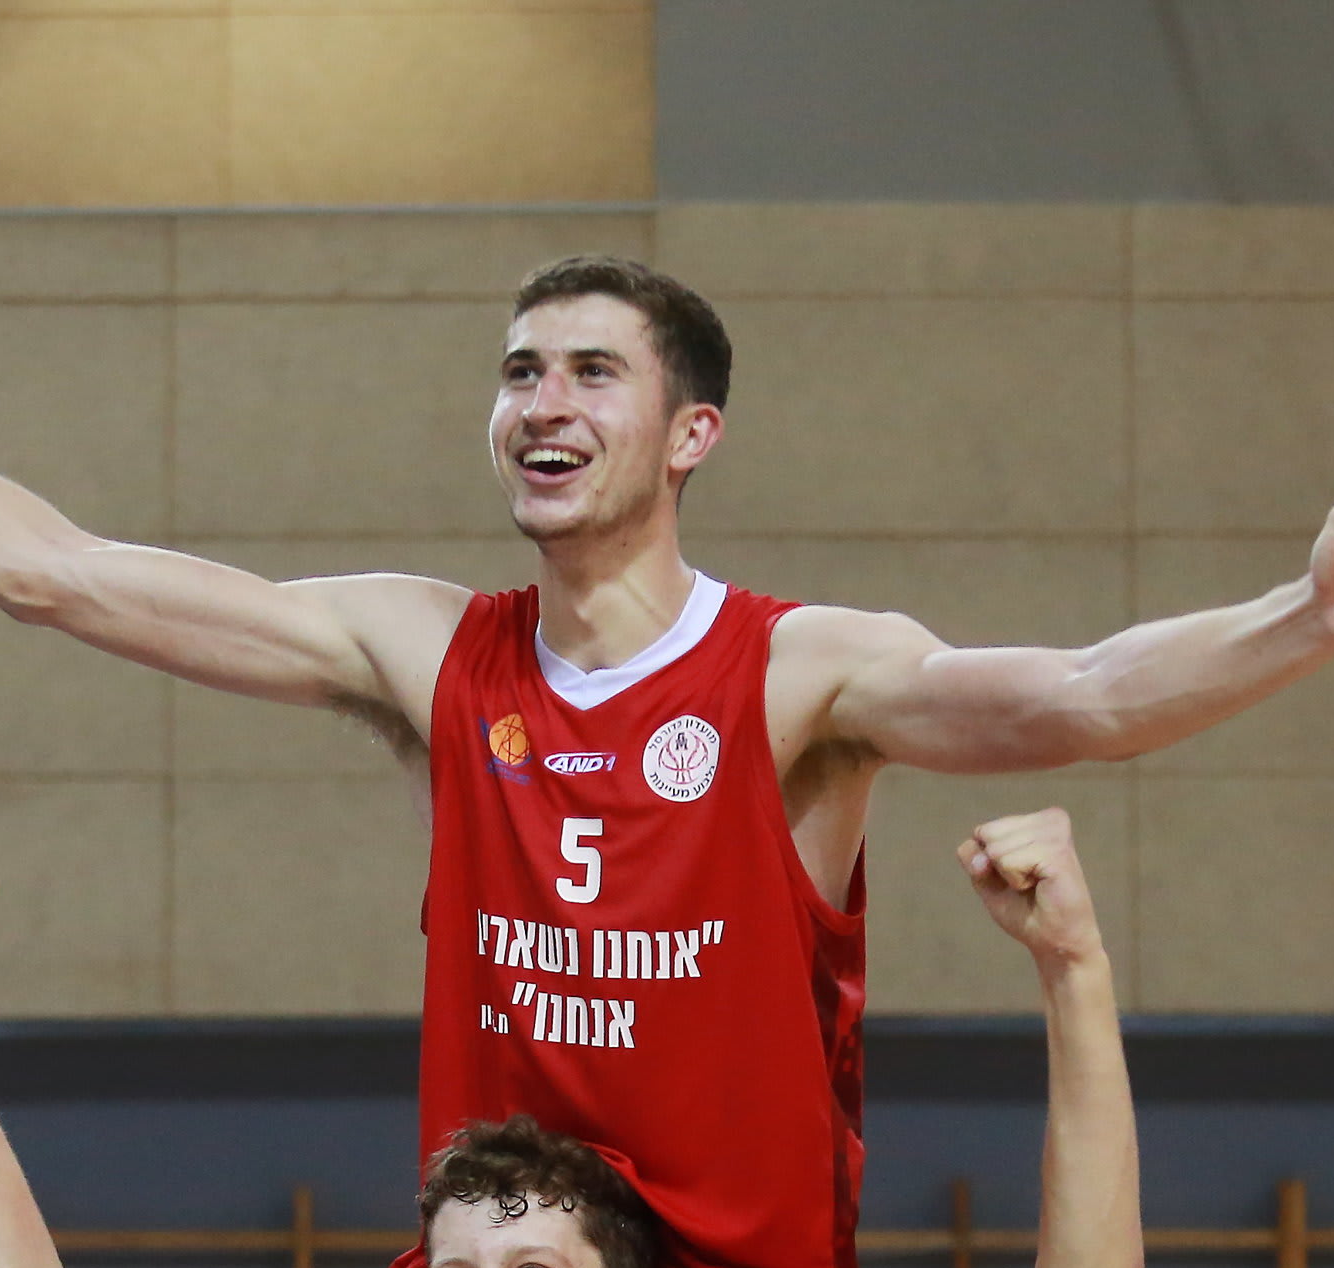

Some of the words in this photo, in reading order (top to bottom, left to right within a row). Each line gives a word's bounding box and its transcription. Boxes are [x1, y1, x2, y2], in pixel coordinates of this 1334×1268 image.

[685, 718, 717, 744] מועדון
[556, 817, 603, 904] 5
[477, 908, 579, 976] נשארי
